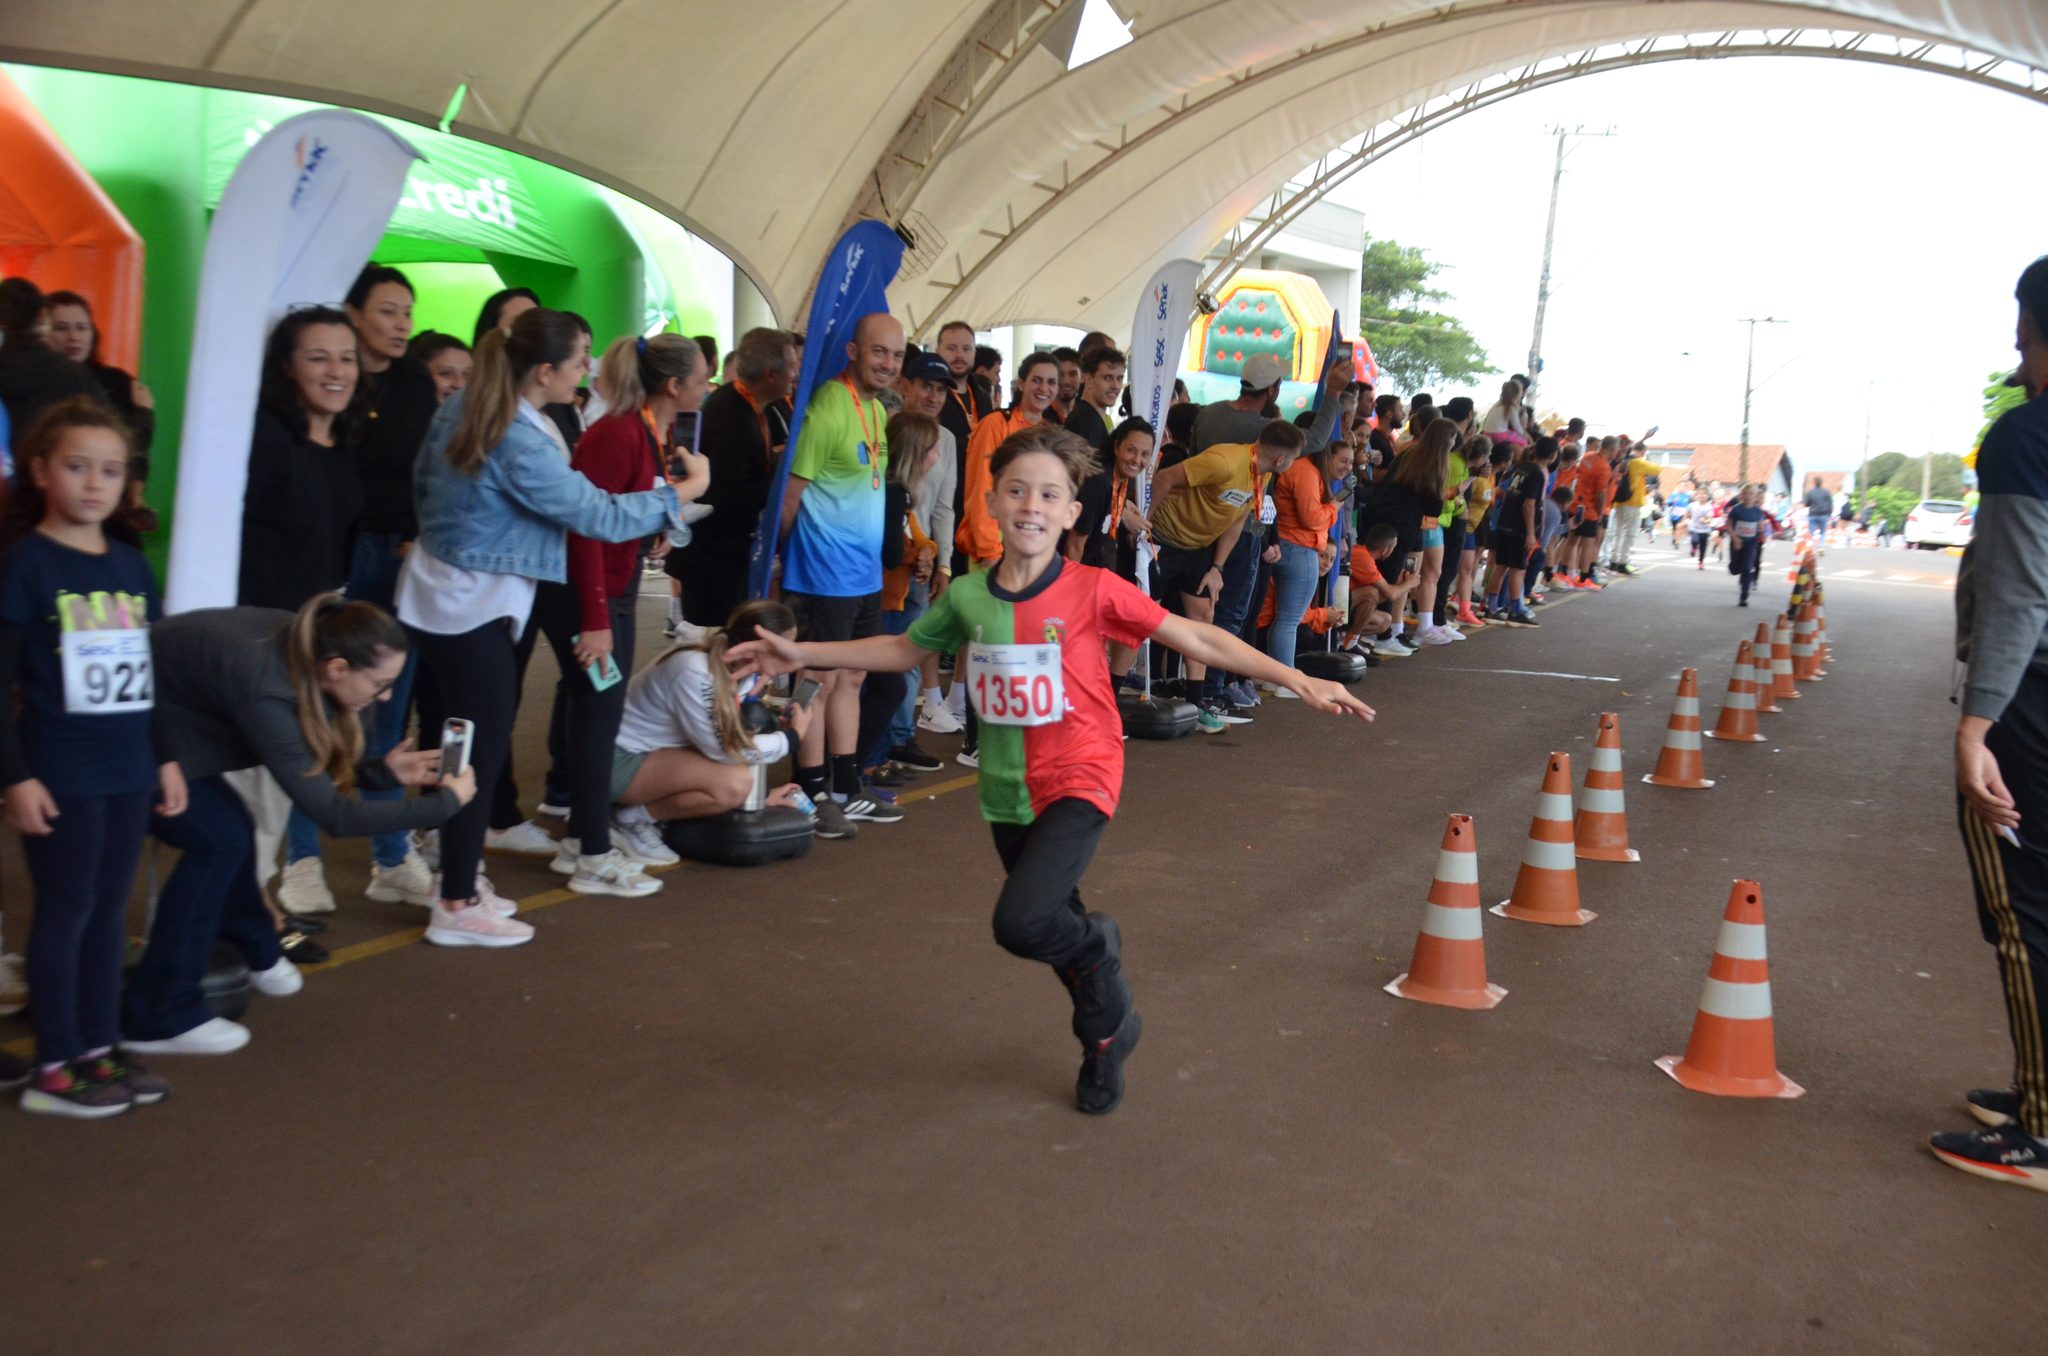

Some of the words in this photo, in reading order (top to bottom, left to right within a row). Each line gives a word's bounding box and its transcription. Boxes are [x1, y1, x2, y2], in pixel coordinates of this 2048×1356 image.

[400, 176, 516, 230] redi
[1157, 282, 1168, 320] Senac
[1154, 338, 1165, 368] Sesc
[976, 672, 1053, 717] 1350
